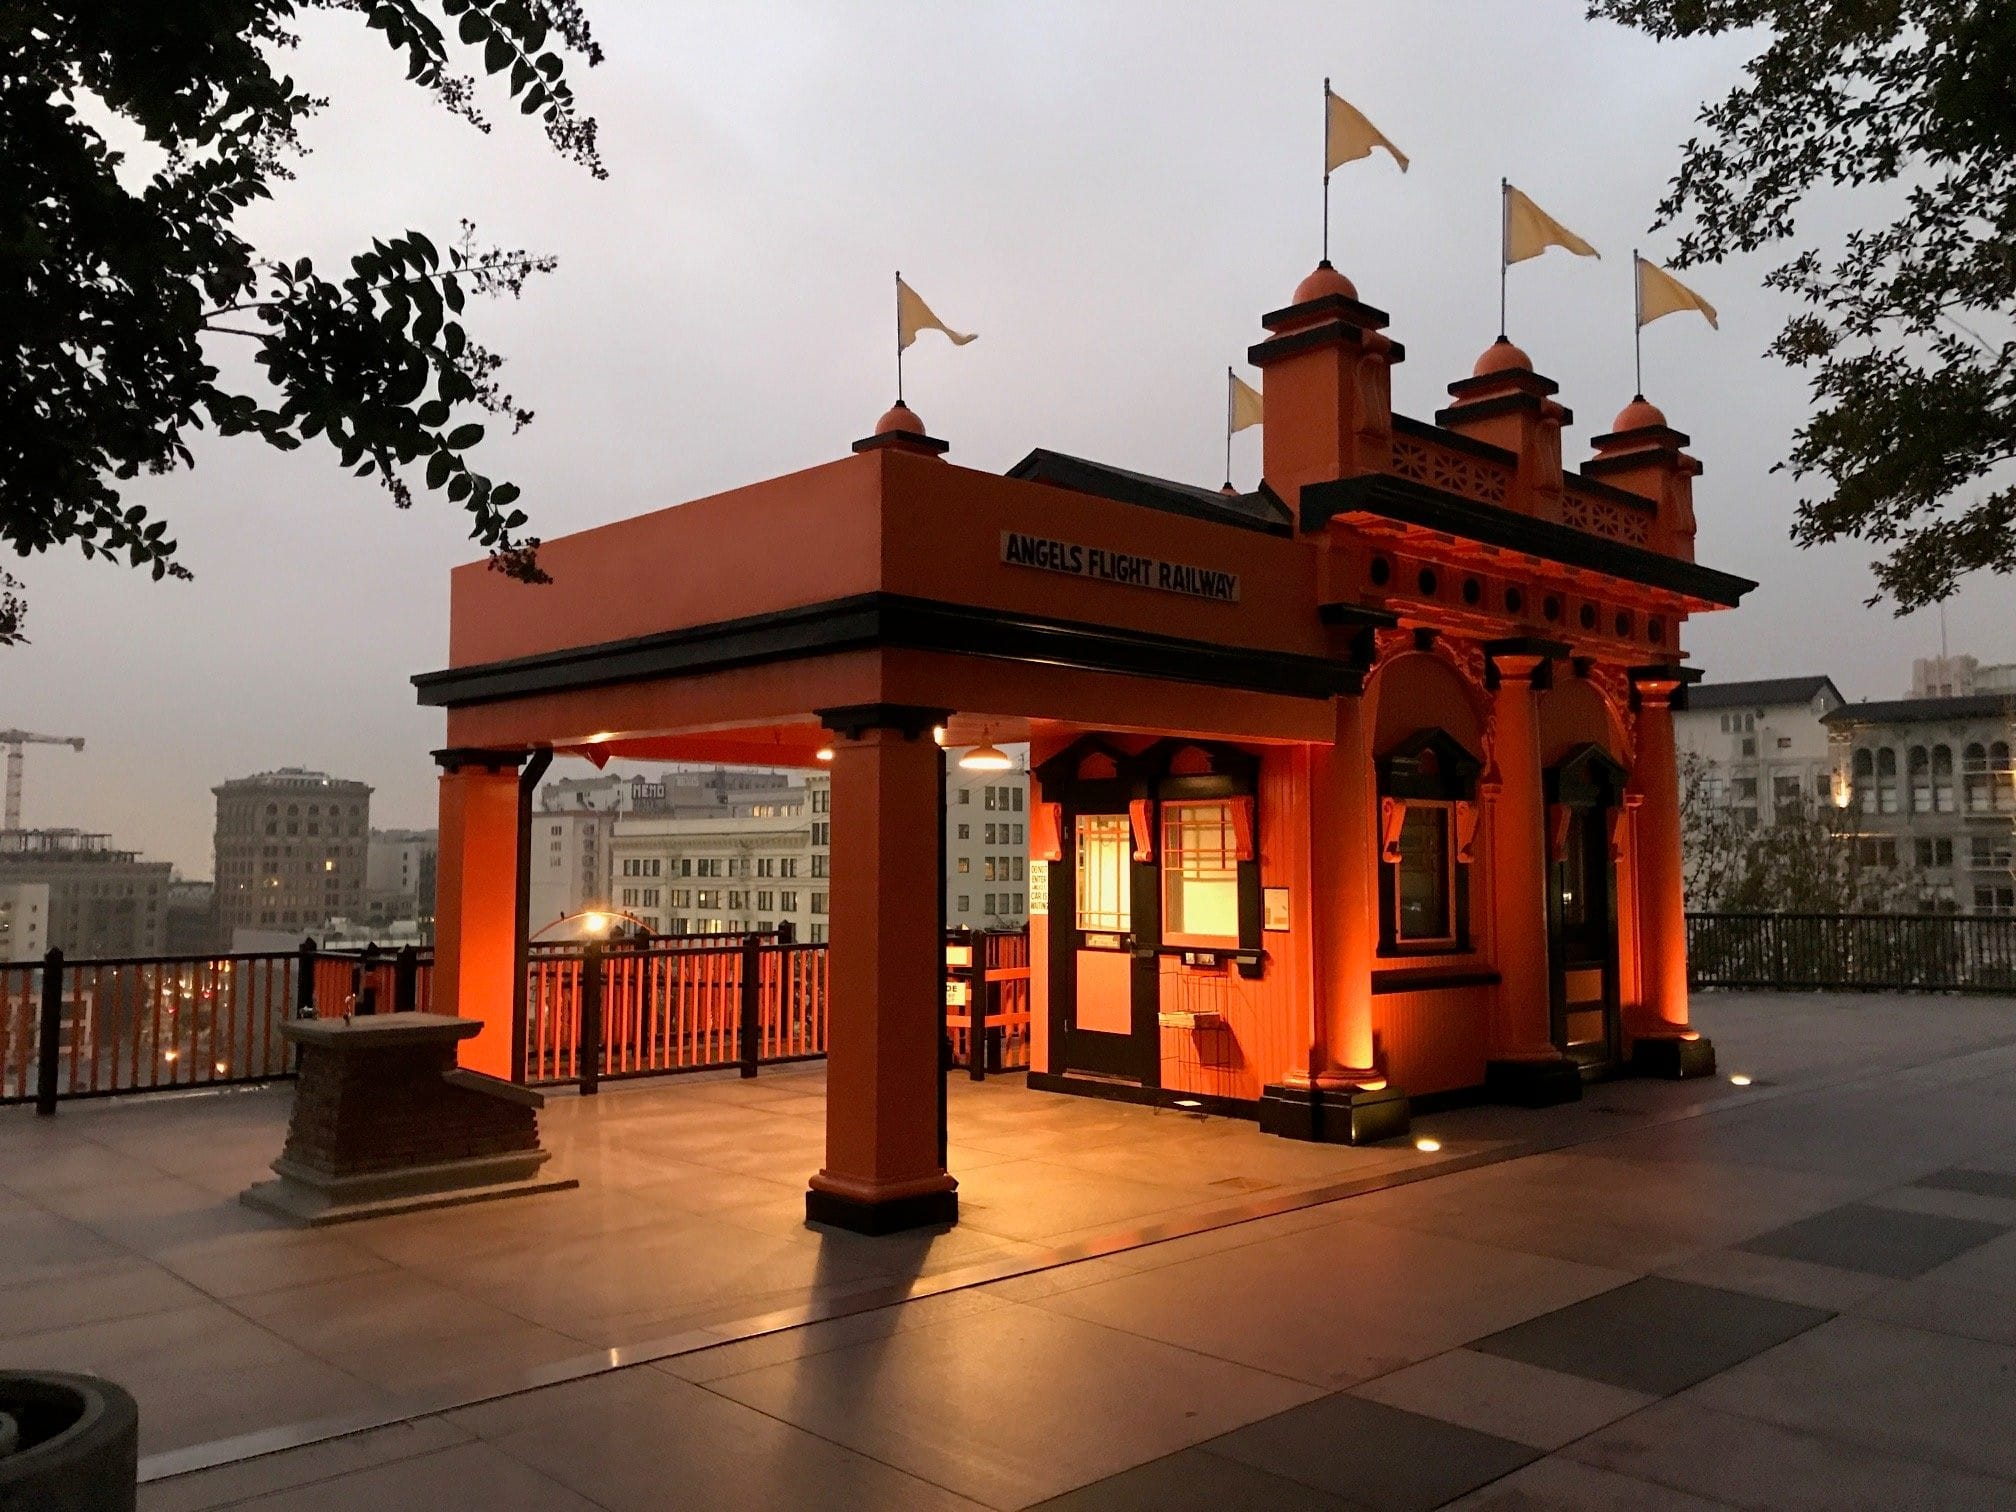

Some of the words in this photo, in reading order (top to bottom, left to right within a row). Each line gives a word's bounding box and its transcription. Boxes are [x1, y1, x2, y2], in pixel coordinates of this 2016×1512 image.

[1006, 533, 1082, 573] ANGELS
[1089, 548, 1152, 585] FLIGHT
[1159, 562, 1238, 600] RAILWAY
[1031, 892, 1041, 900] CAR
